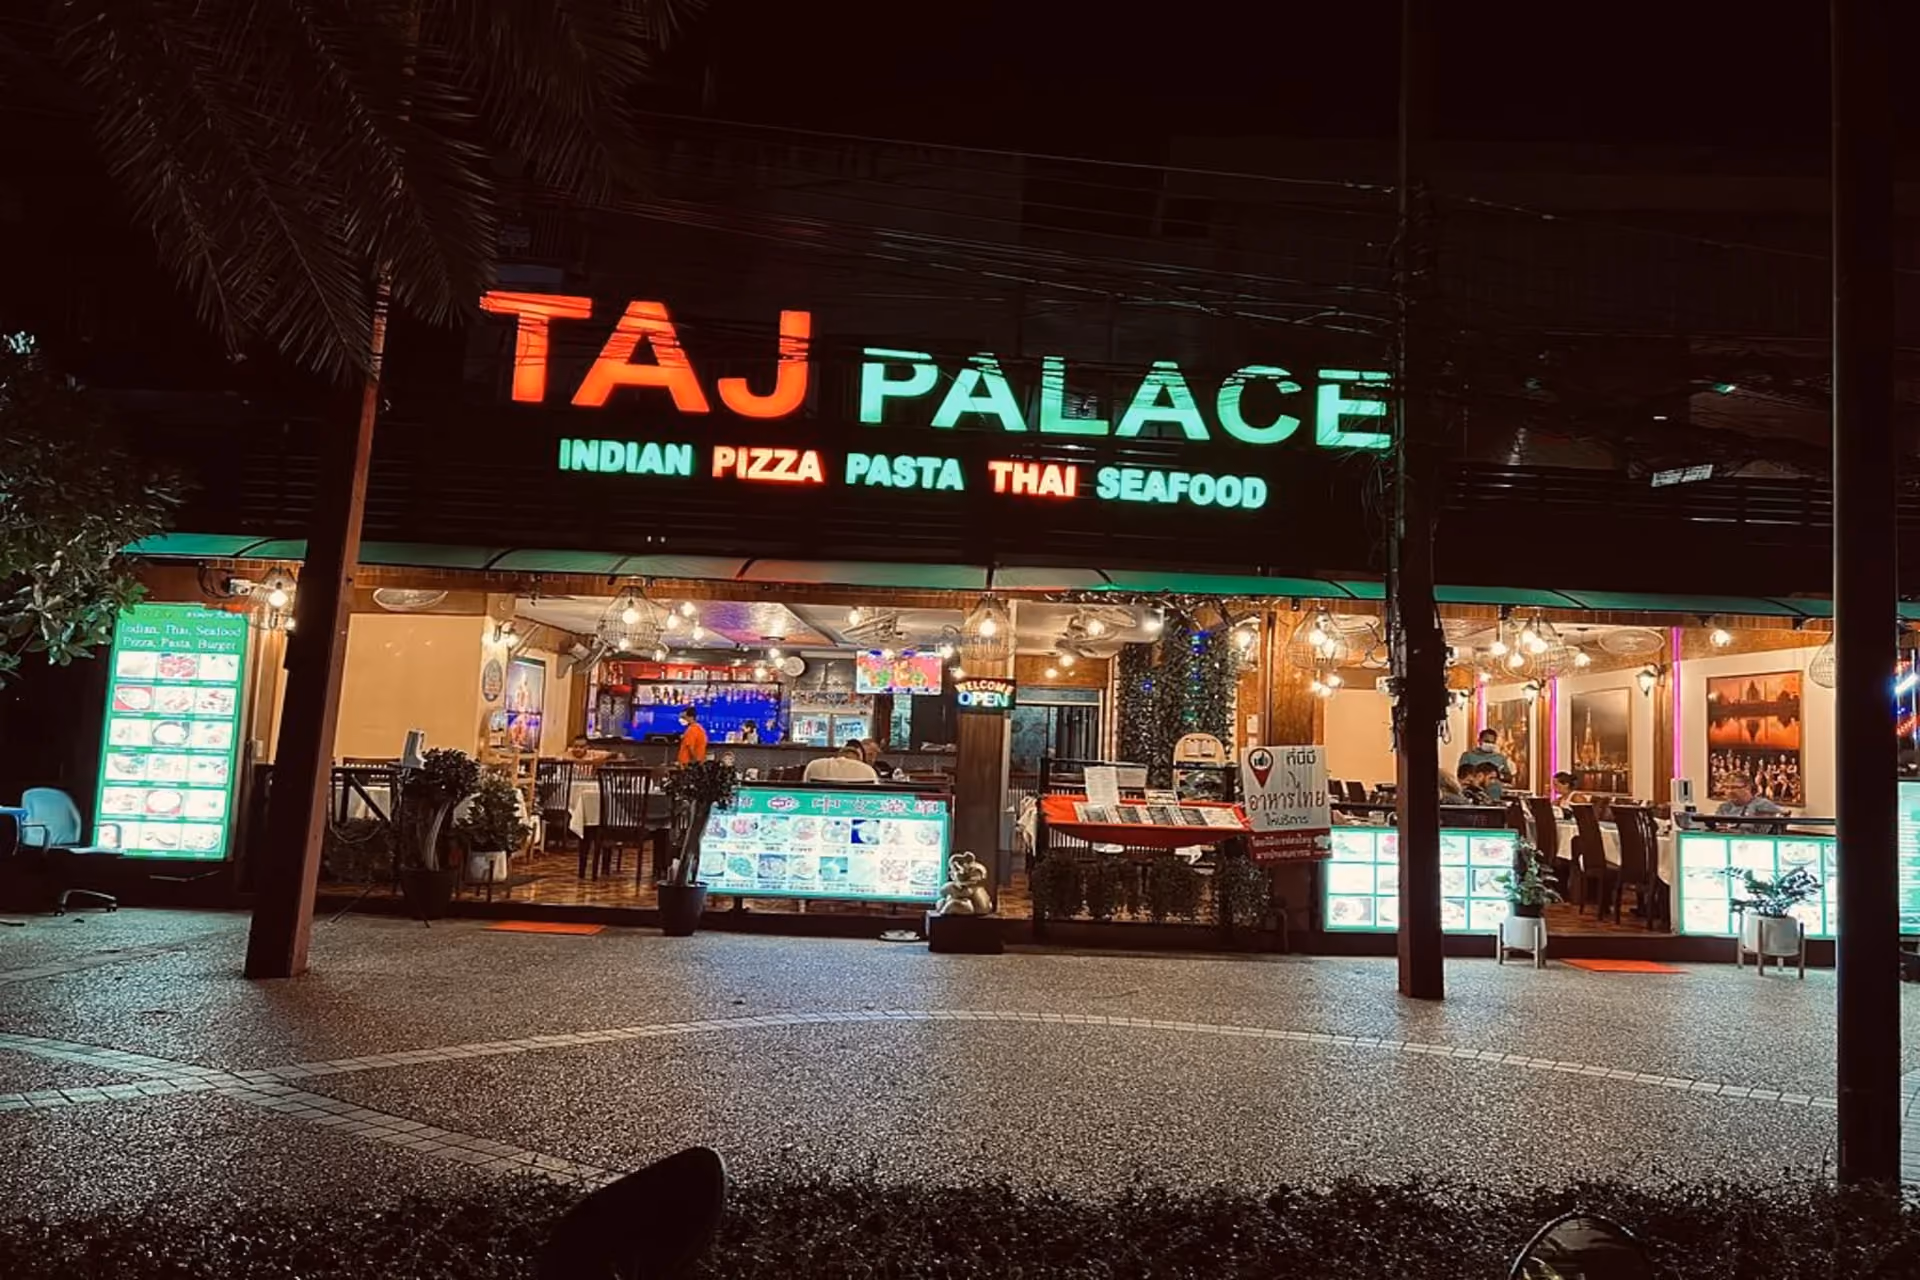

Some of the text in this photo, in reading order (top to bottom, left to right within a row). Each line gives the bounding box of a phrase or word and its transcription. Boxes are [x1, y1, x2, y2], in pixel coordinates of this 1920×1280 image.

[480, 291, 1393, 449] TAJ PALACE
[560, 439, 1266, 508] INDIAN PIZZA PASTA THAI SEAFOOD
[955, 680, 1014, 696] WELCOME
[958, 692, 1008, 708] OPEN
